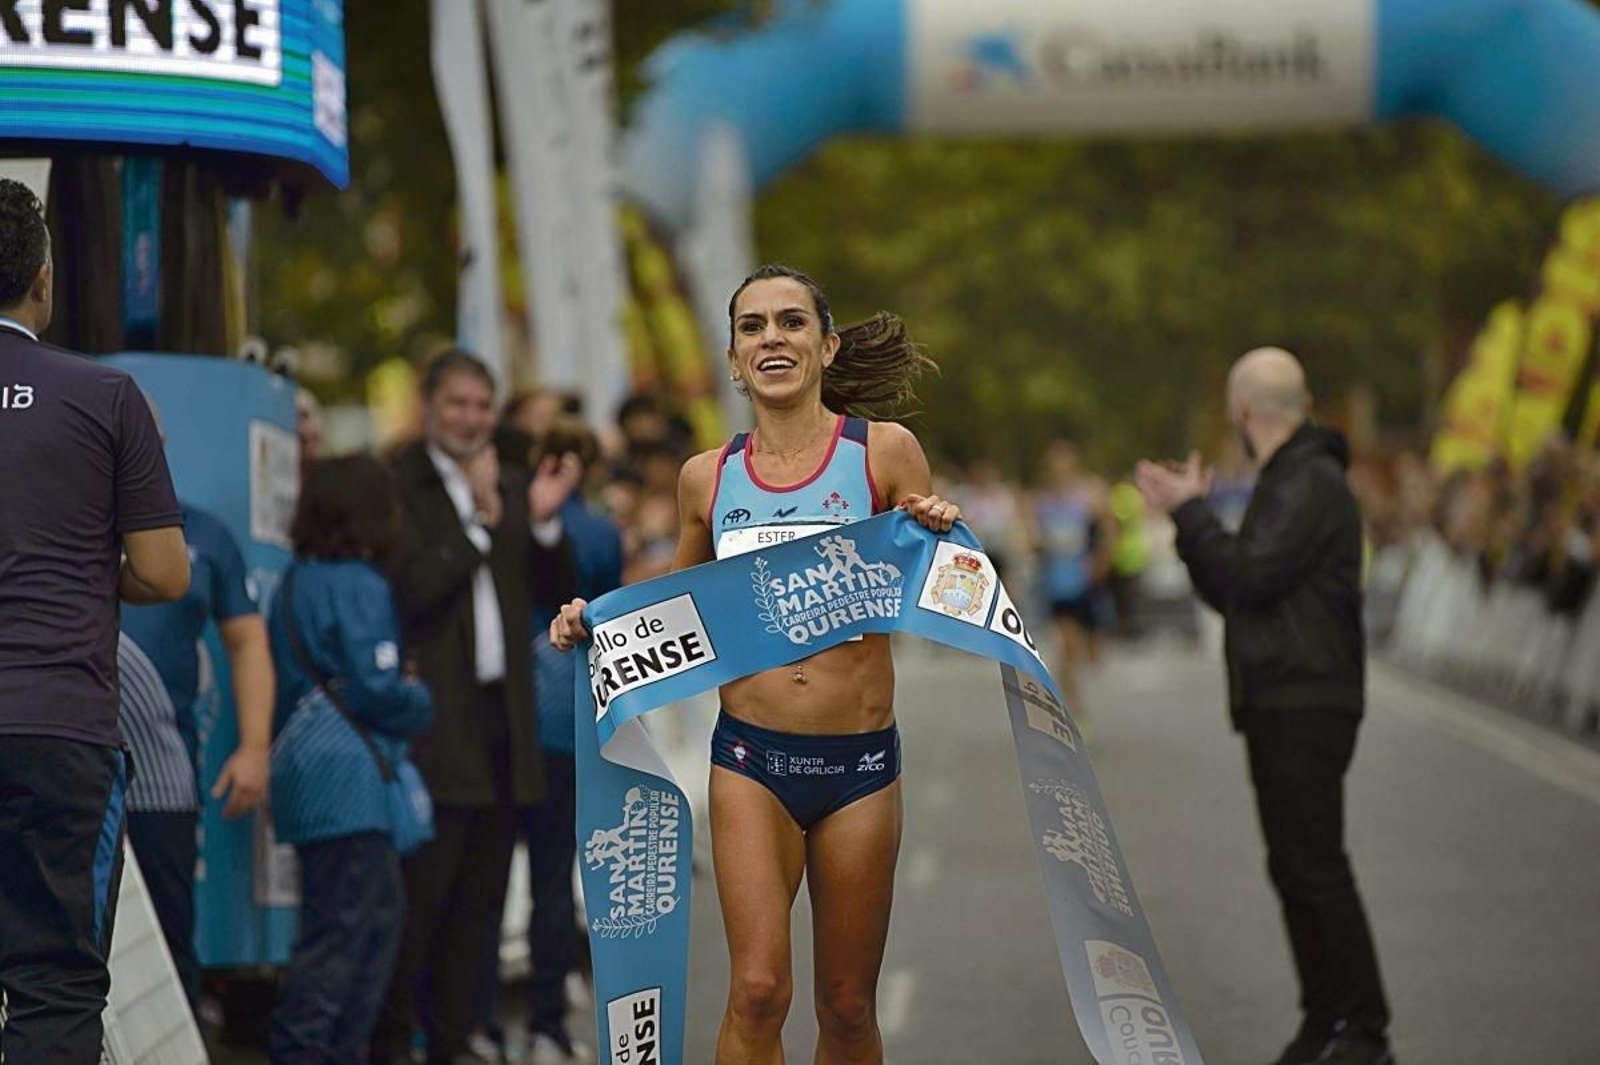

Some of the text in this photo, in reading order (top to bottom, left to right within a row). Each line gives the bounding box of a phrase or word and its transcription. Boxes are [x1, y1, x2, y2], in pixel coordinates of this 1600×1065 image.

[758, 531, 796, 544] ESTER
[769, 563, 829, 597] SAN
[776, 569, 889, 616] MARTIN
[782, 607, 827, 628] CARREIRA
[827, 589, 871, 615] PEDESTRE
[634, 616, 665, 639] de
[594, 631, 706, 708] URENSE
[788, 756, 824, 766] XUNTA
[789, 765, 845, 775] DE GALICIA
[627, 807, 648, 916] MARTIN
[645, 790, 662, 915] CARREIRA PEDESTRE POPULAR
[609, 863, 626, 920] SAN
[615, 1033, 630, 1063] de
